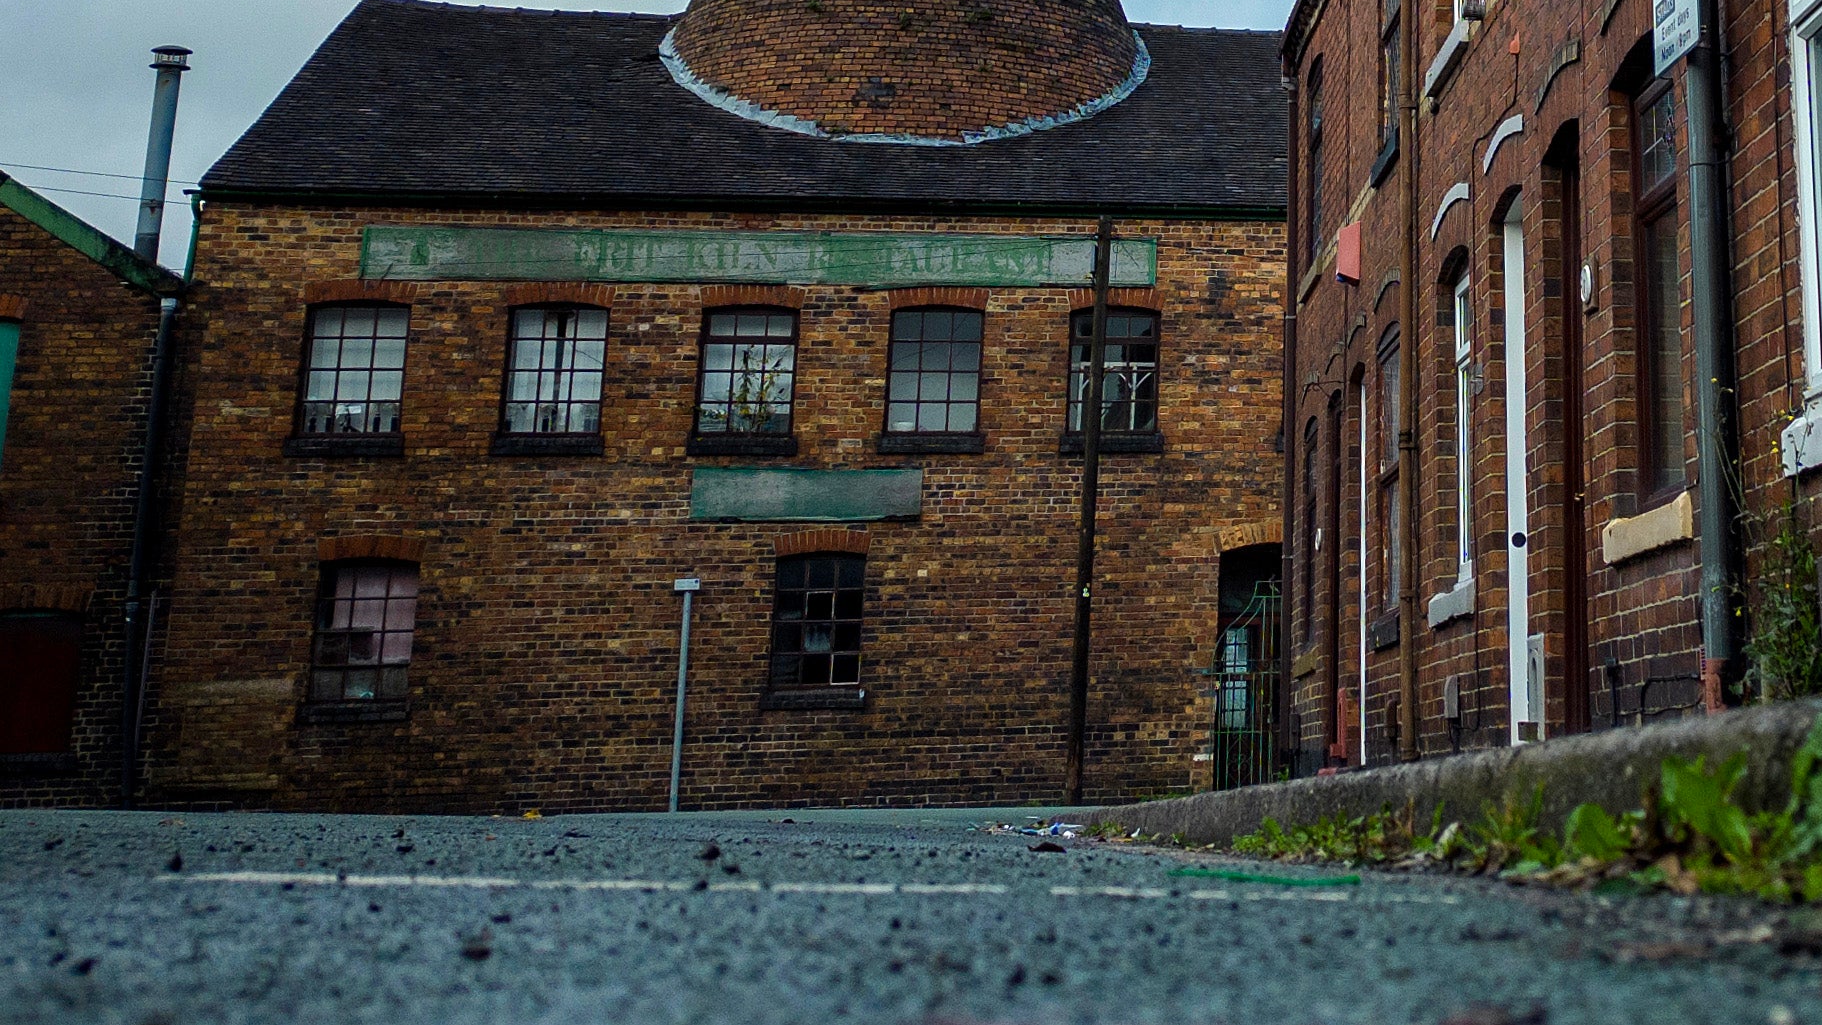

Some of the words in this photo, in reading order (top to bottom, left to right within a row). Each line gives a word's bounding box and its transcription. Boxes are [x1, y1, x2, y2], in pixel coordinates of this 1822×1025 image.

[1661, 19, 1675, 41] Event
[1678, 8, 1690, 27] days
[1661, 43, 1675, 61] Noon
[807, 243, 1050, 273] RTAURANT
